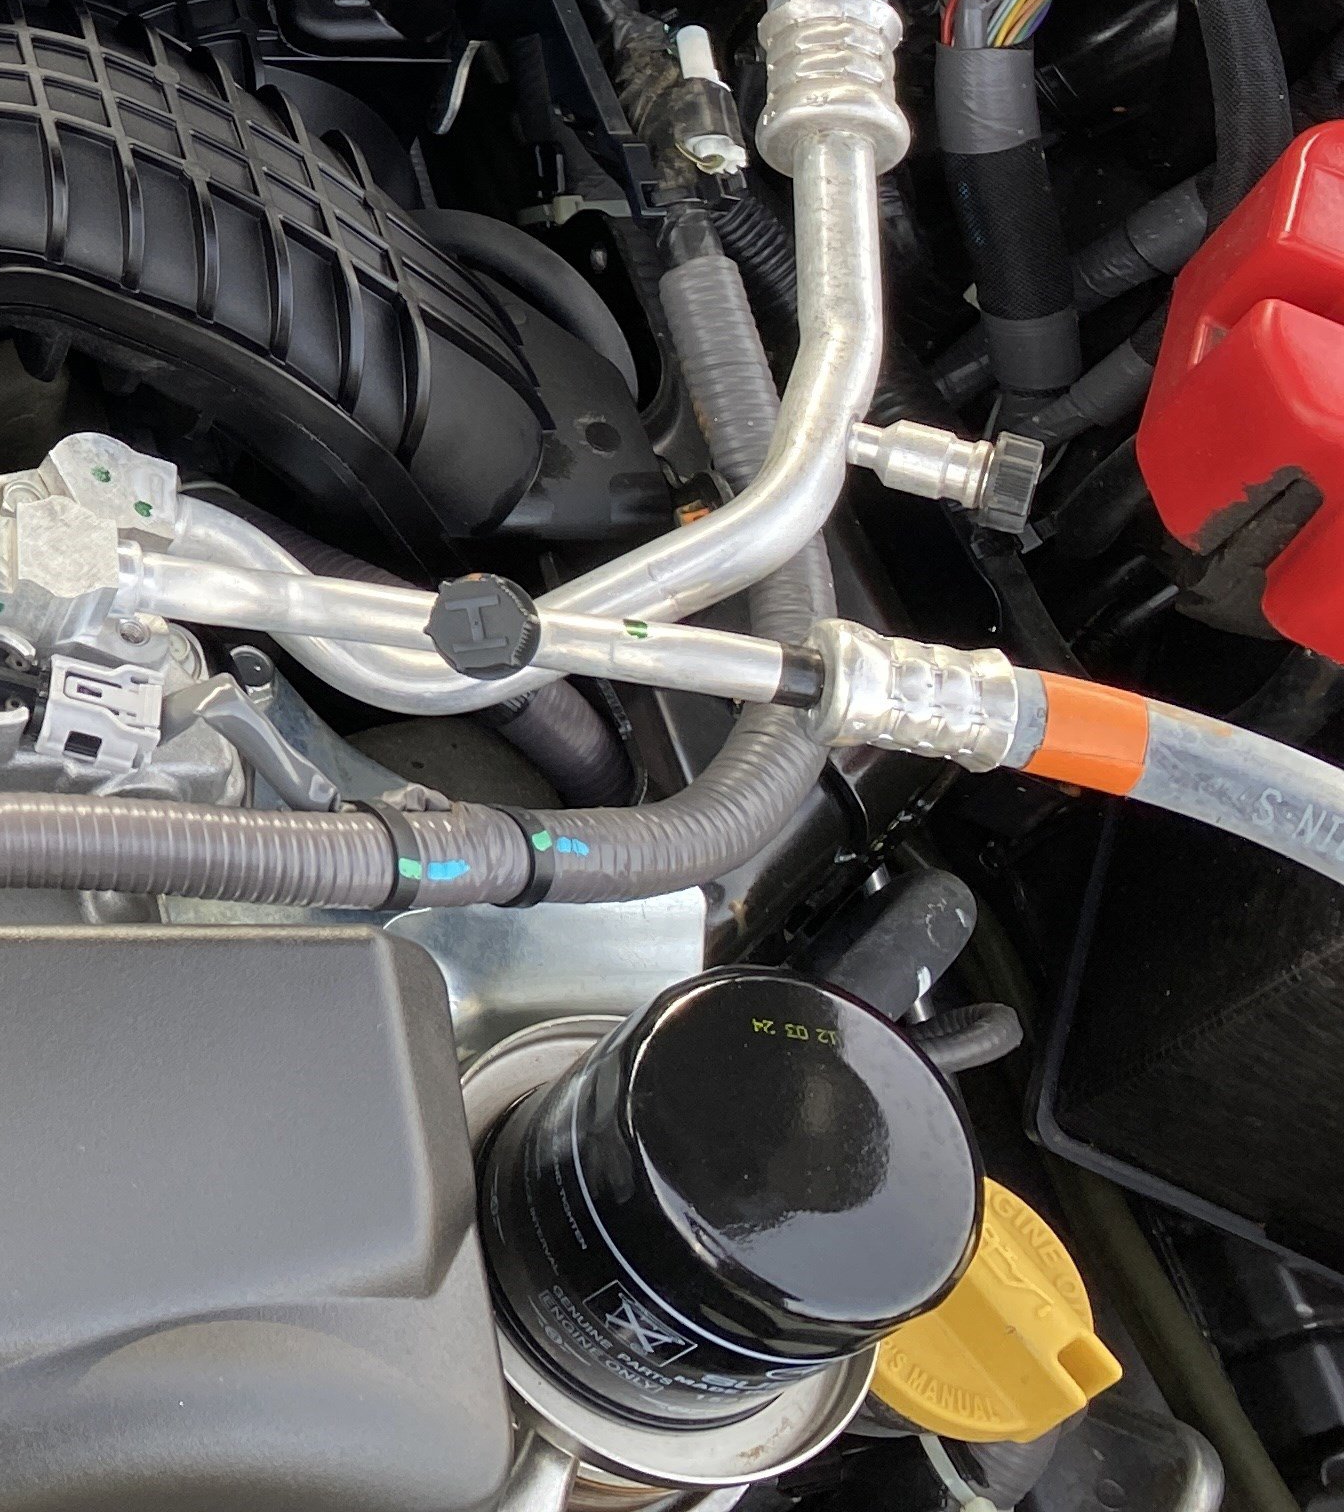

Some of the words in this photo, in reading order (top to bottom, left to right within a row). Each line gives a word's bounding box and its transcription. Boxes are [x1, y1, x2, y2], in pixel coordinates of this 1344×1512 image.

[752, 1018, 776, 1035] 24
[785, 1023, 809, 1040] 03
[816, 1029, 836, 1045] 12
[560, 1187, 587, 1250] TIGHTEN
[989, 1191, 1066, 1268] GINE
[543, 1292, 606, 1357] ENGINE
[604, 1358, 652, 1390] ONLY
[552, 1284, 613, 1350] GENUINE
[617, 1353, 673, 1386] PARTS
[907, 1366, 1002, 1424] MANUAL
